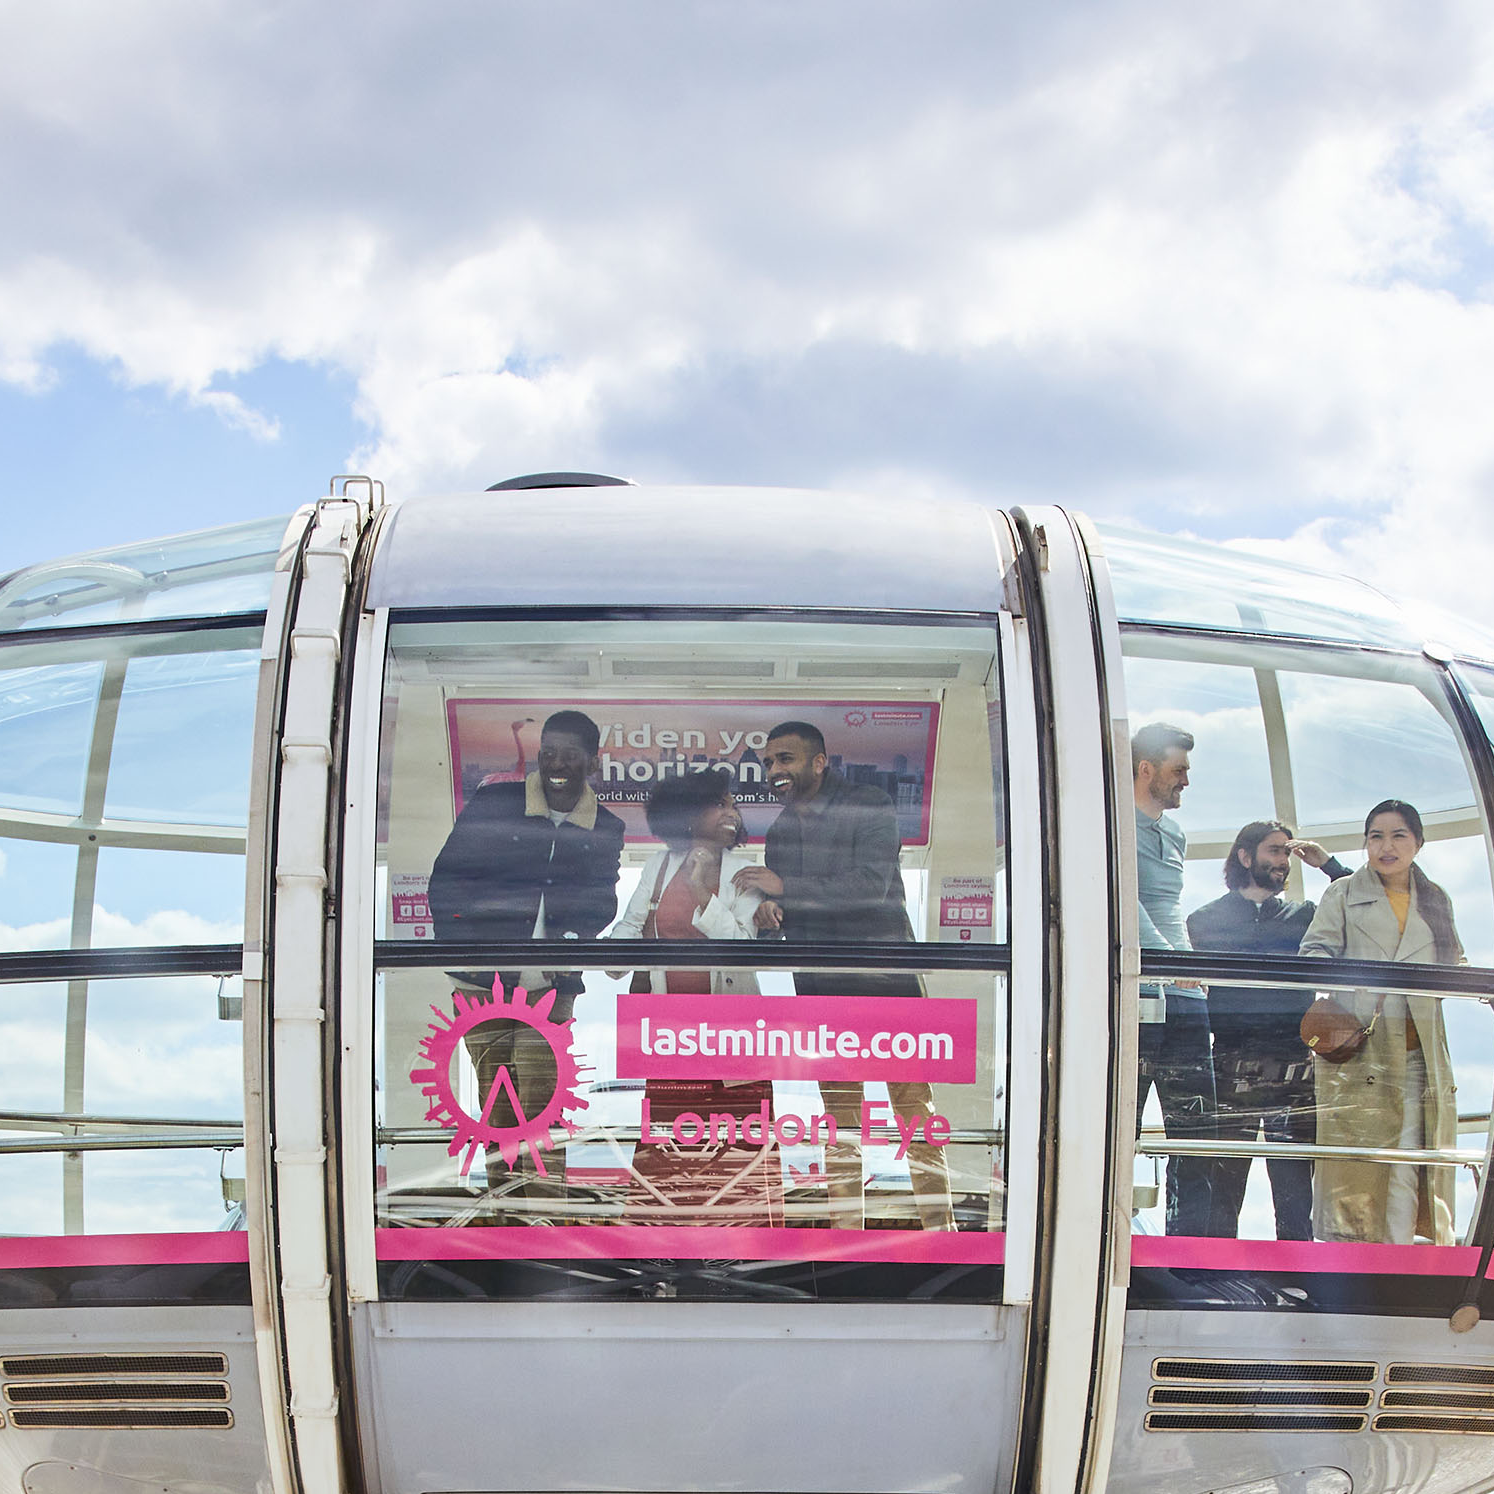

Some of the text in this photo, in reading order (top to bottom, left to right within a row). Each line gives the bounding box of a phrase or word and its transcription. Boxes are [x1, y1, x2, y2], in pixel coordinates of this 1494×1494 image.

[599, 723, 768, 755] iden yo
[640, 1017, 954, 1060] lastminute.com
[641, 1098, 951, 1160] London Eye
